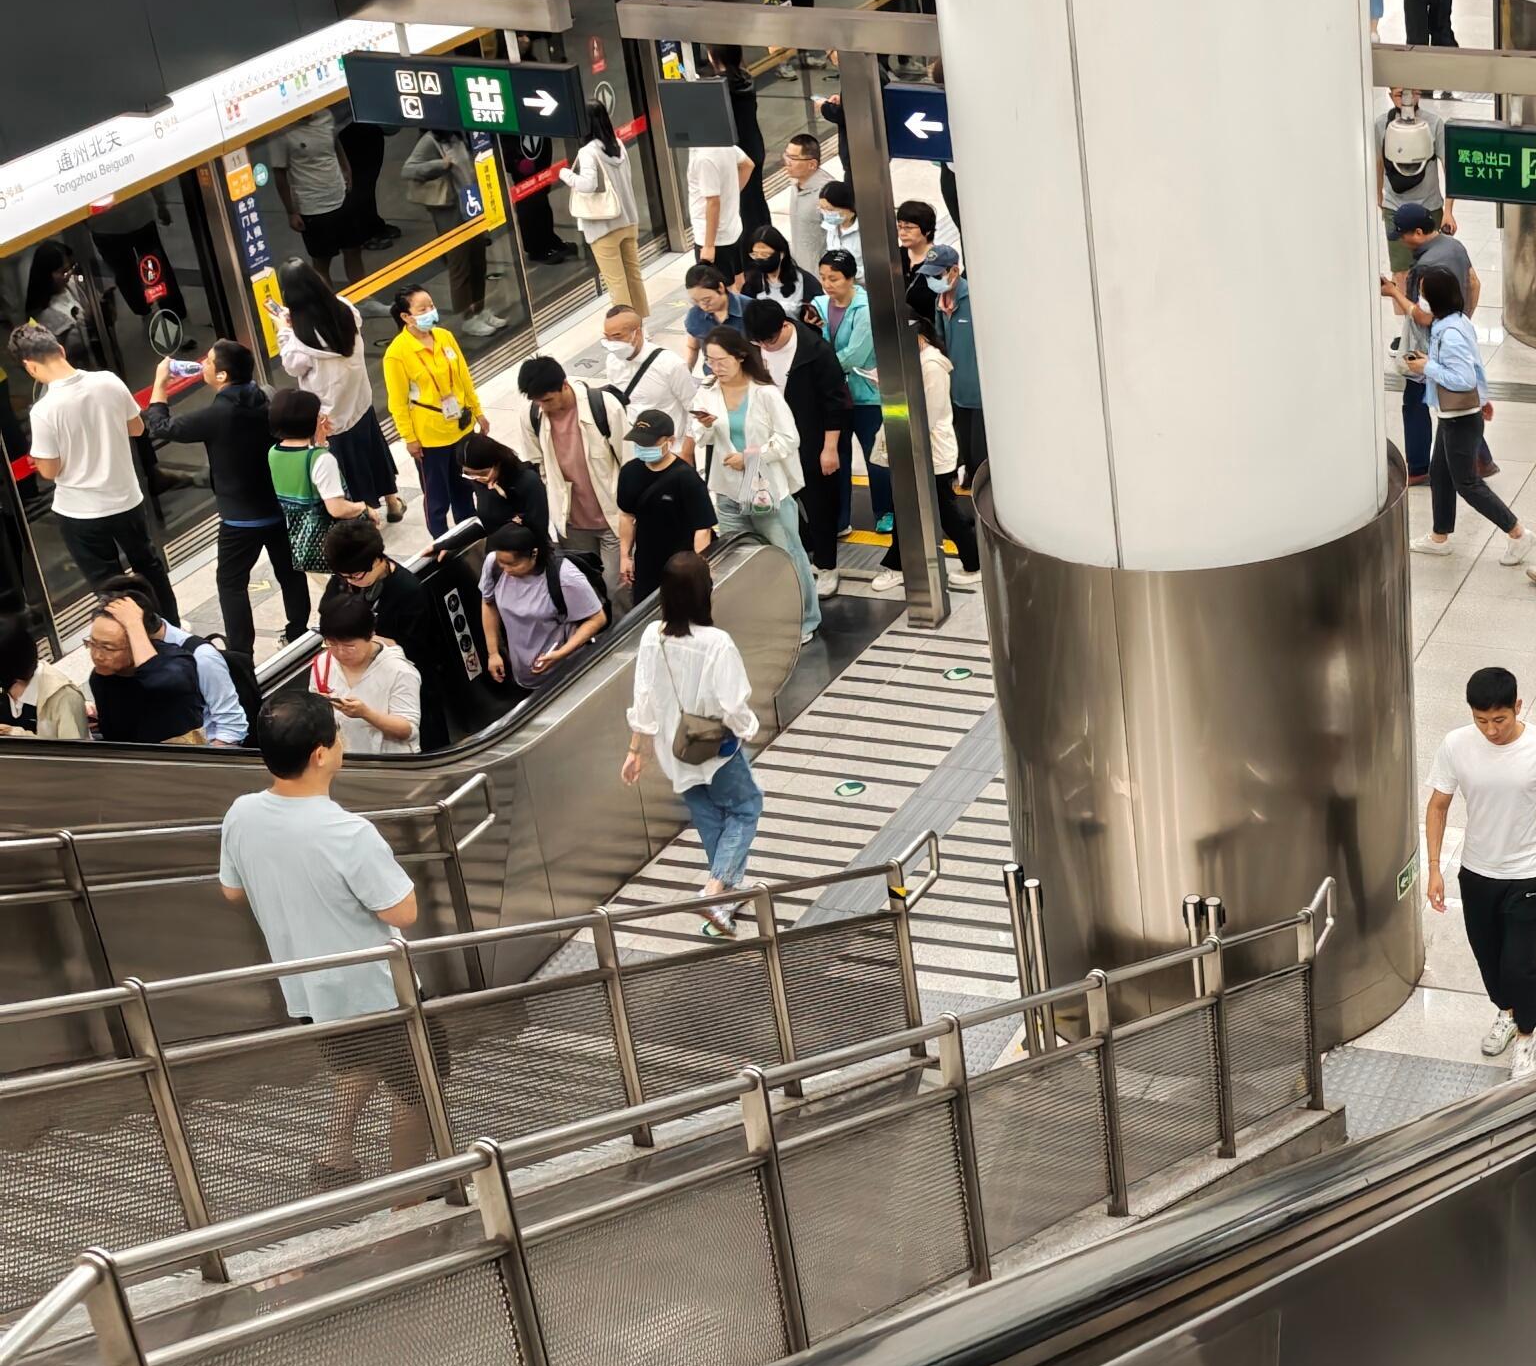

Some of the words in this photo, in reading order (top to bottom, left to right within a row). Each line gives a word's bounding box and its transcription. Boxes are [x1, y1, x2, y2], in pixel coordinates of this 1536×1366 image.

[472, 109, 504, 123] EXIT
[56, 130, 122, 174] 通州北关
[1457, 148, 1511, 166] 紧急出口
[53, 170, 99, 197] Tongzhou
[99, 153, 135, 184] Beiguan
[1464, 166, 1504, 180] EXIT
